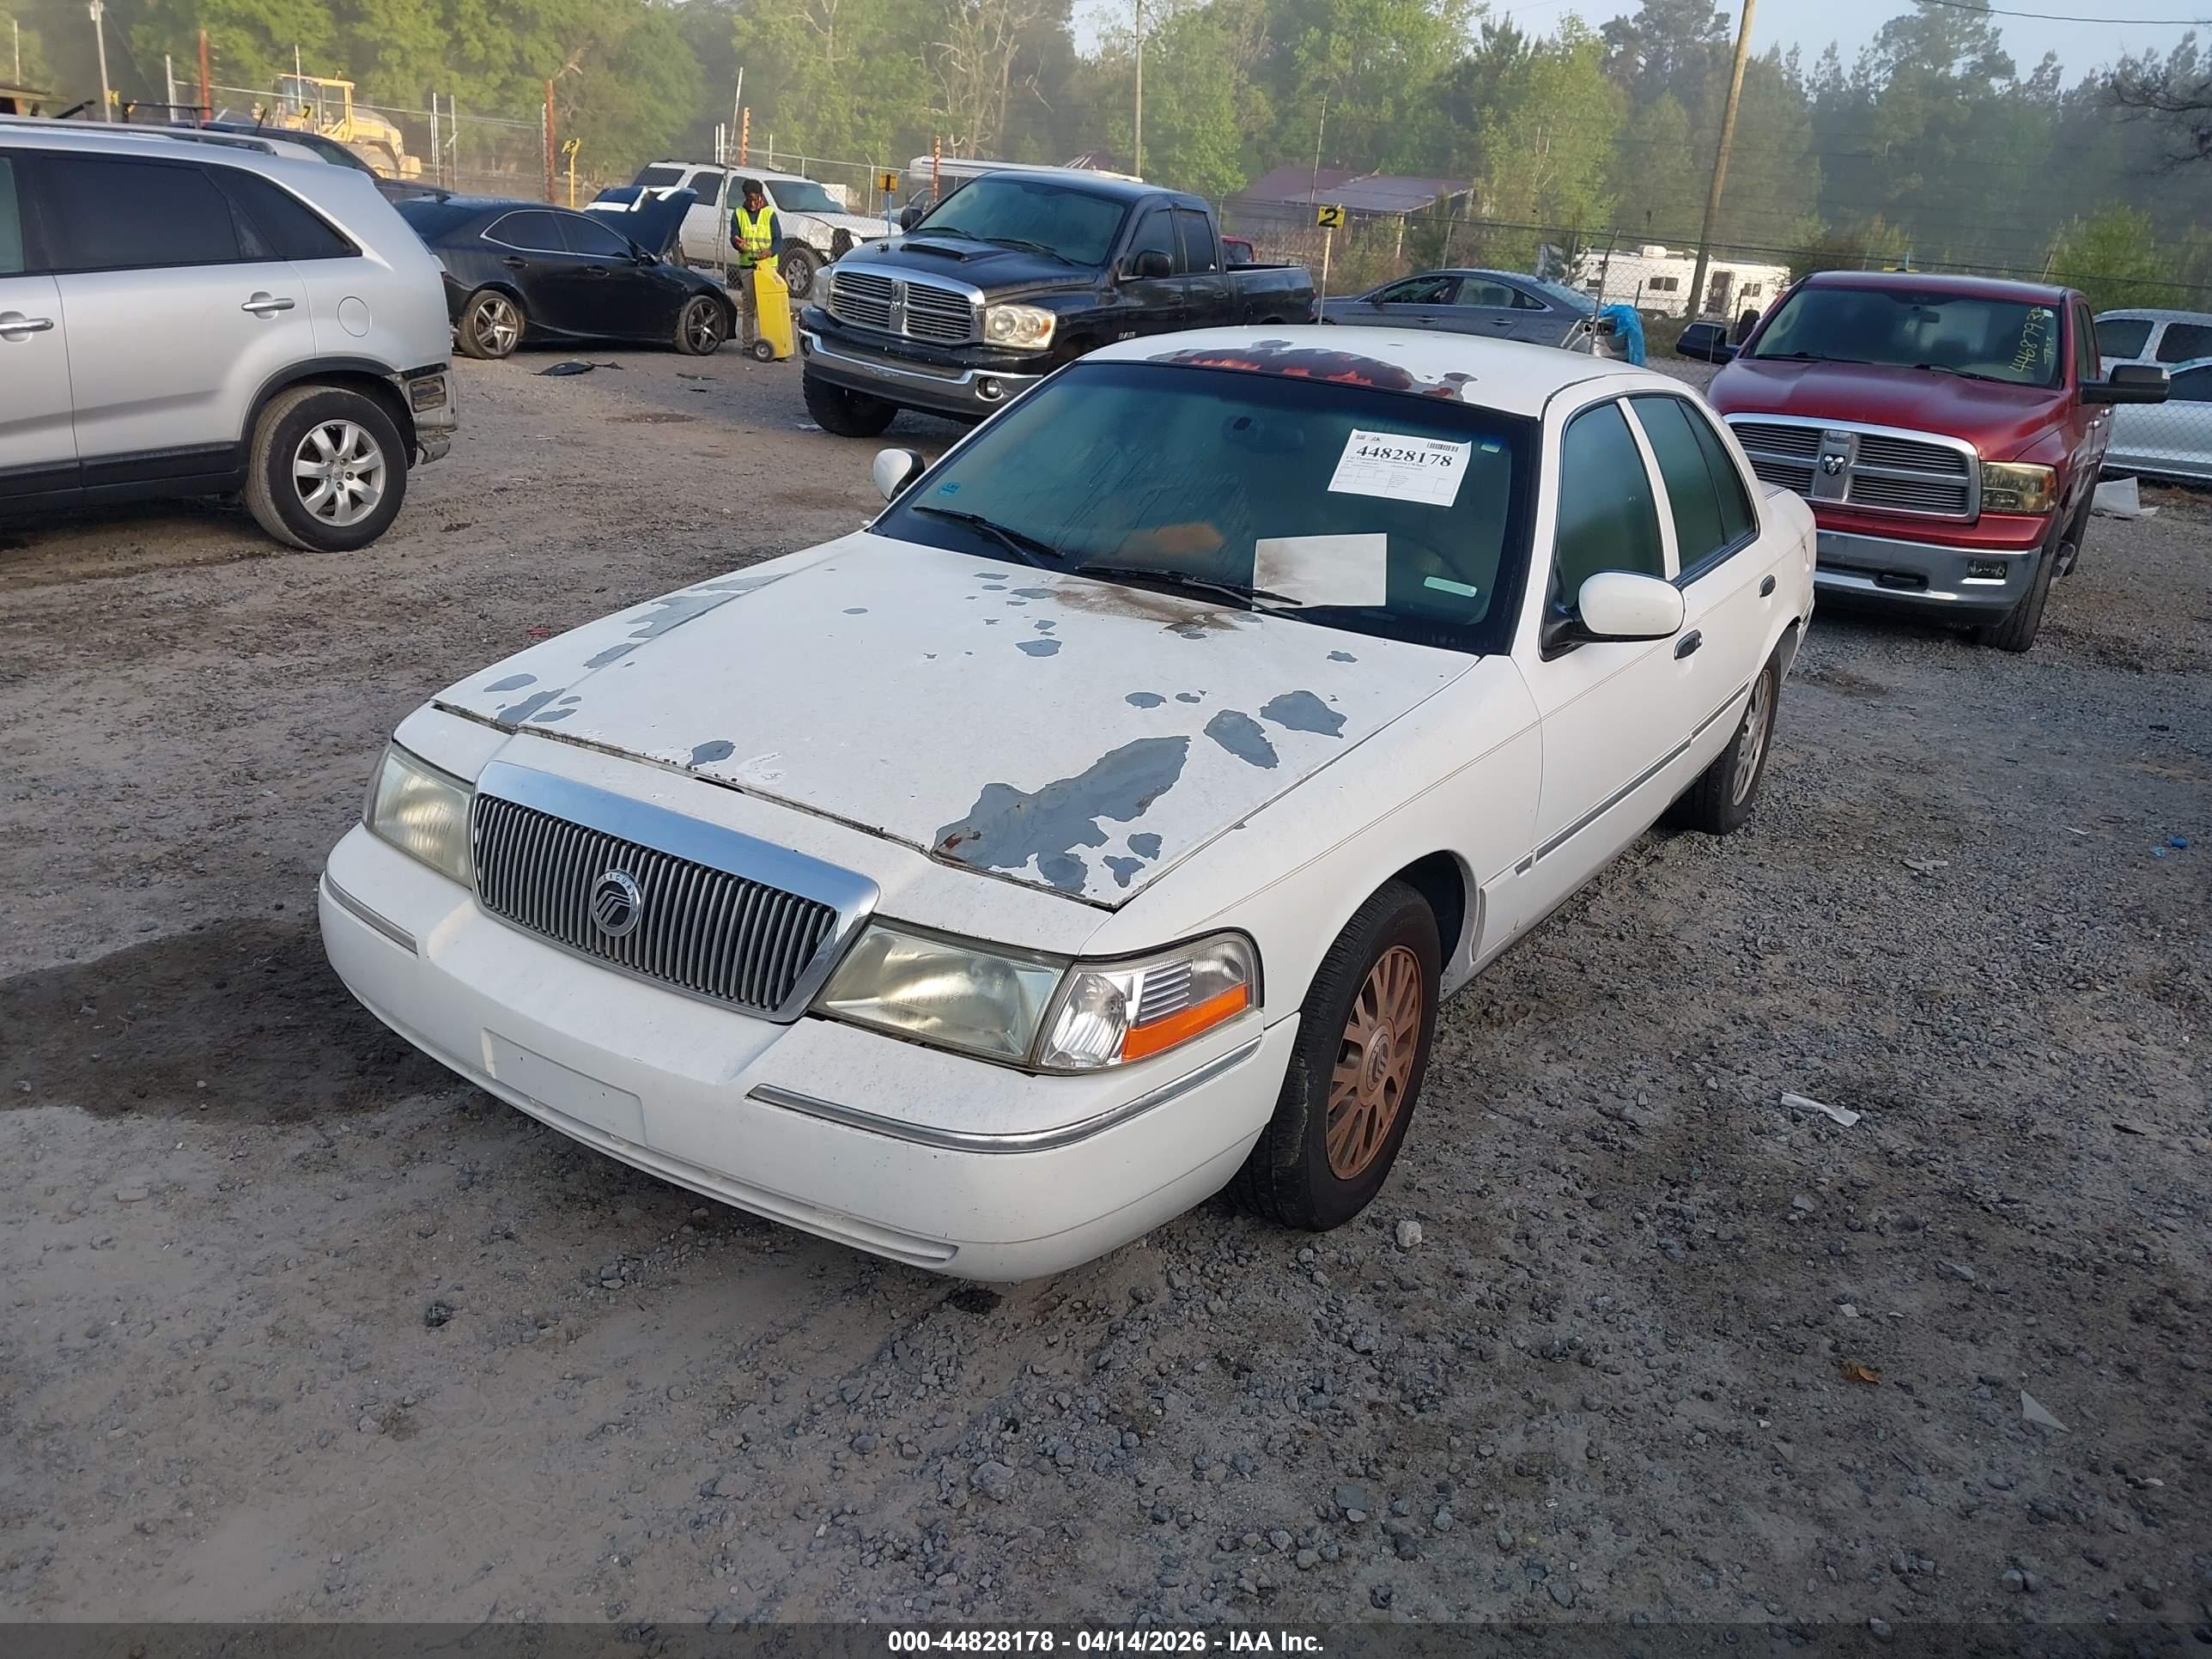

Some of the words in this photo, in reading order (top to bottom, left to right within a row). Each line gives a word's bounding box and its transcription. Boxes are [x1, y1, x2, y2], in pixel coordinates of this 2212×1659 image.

[303, 105, 311, 118] 7
[1319, 208, 1338, 228] 2
[1357, 445, 1453, 467] 44828178
